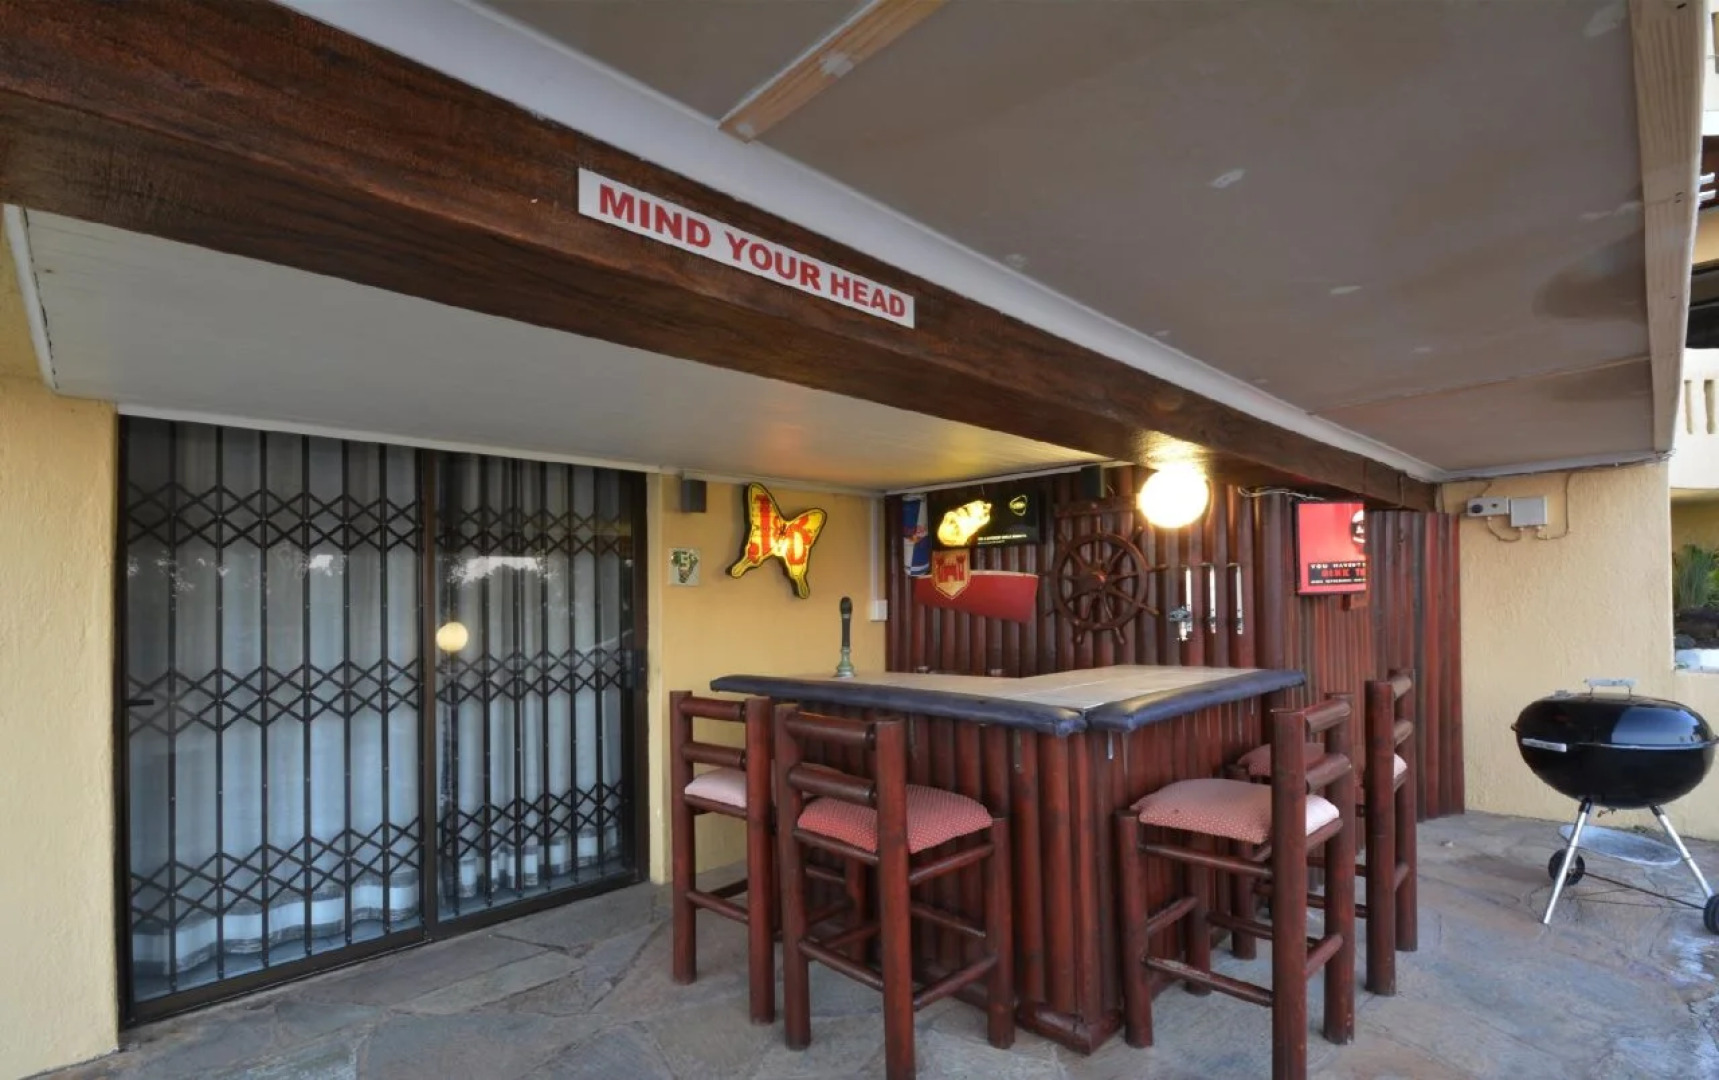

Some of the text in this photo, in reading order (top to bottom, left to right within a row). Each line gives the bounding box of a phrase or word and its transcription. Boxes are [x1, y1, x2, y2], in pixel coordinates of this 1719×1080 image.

[600, 183, 905, 318] MIND YOUR HEAD
